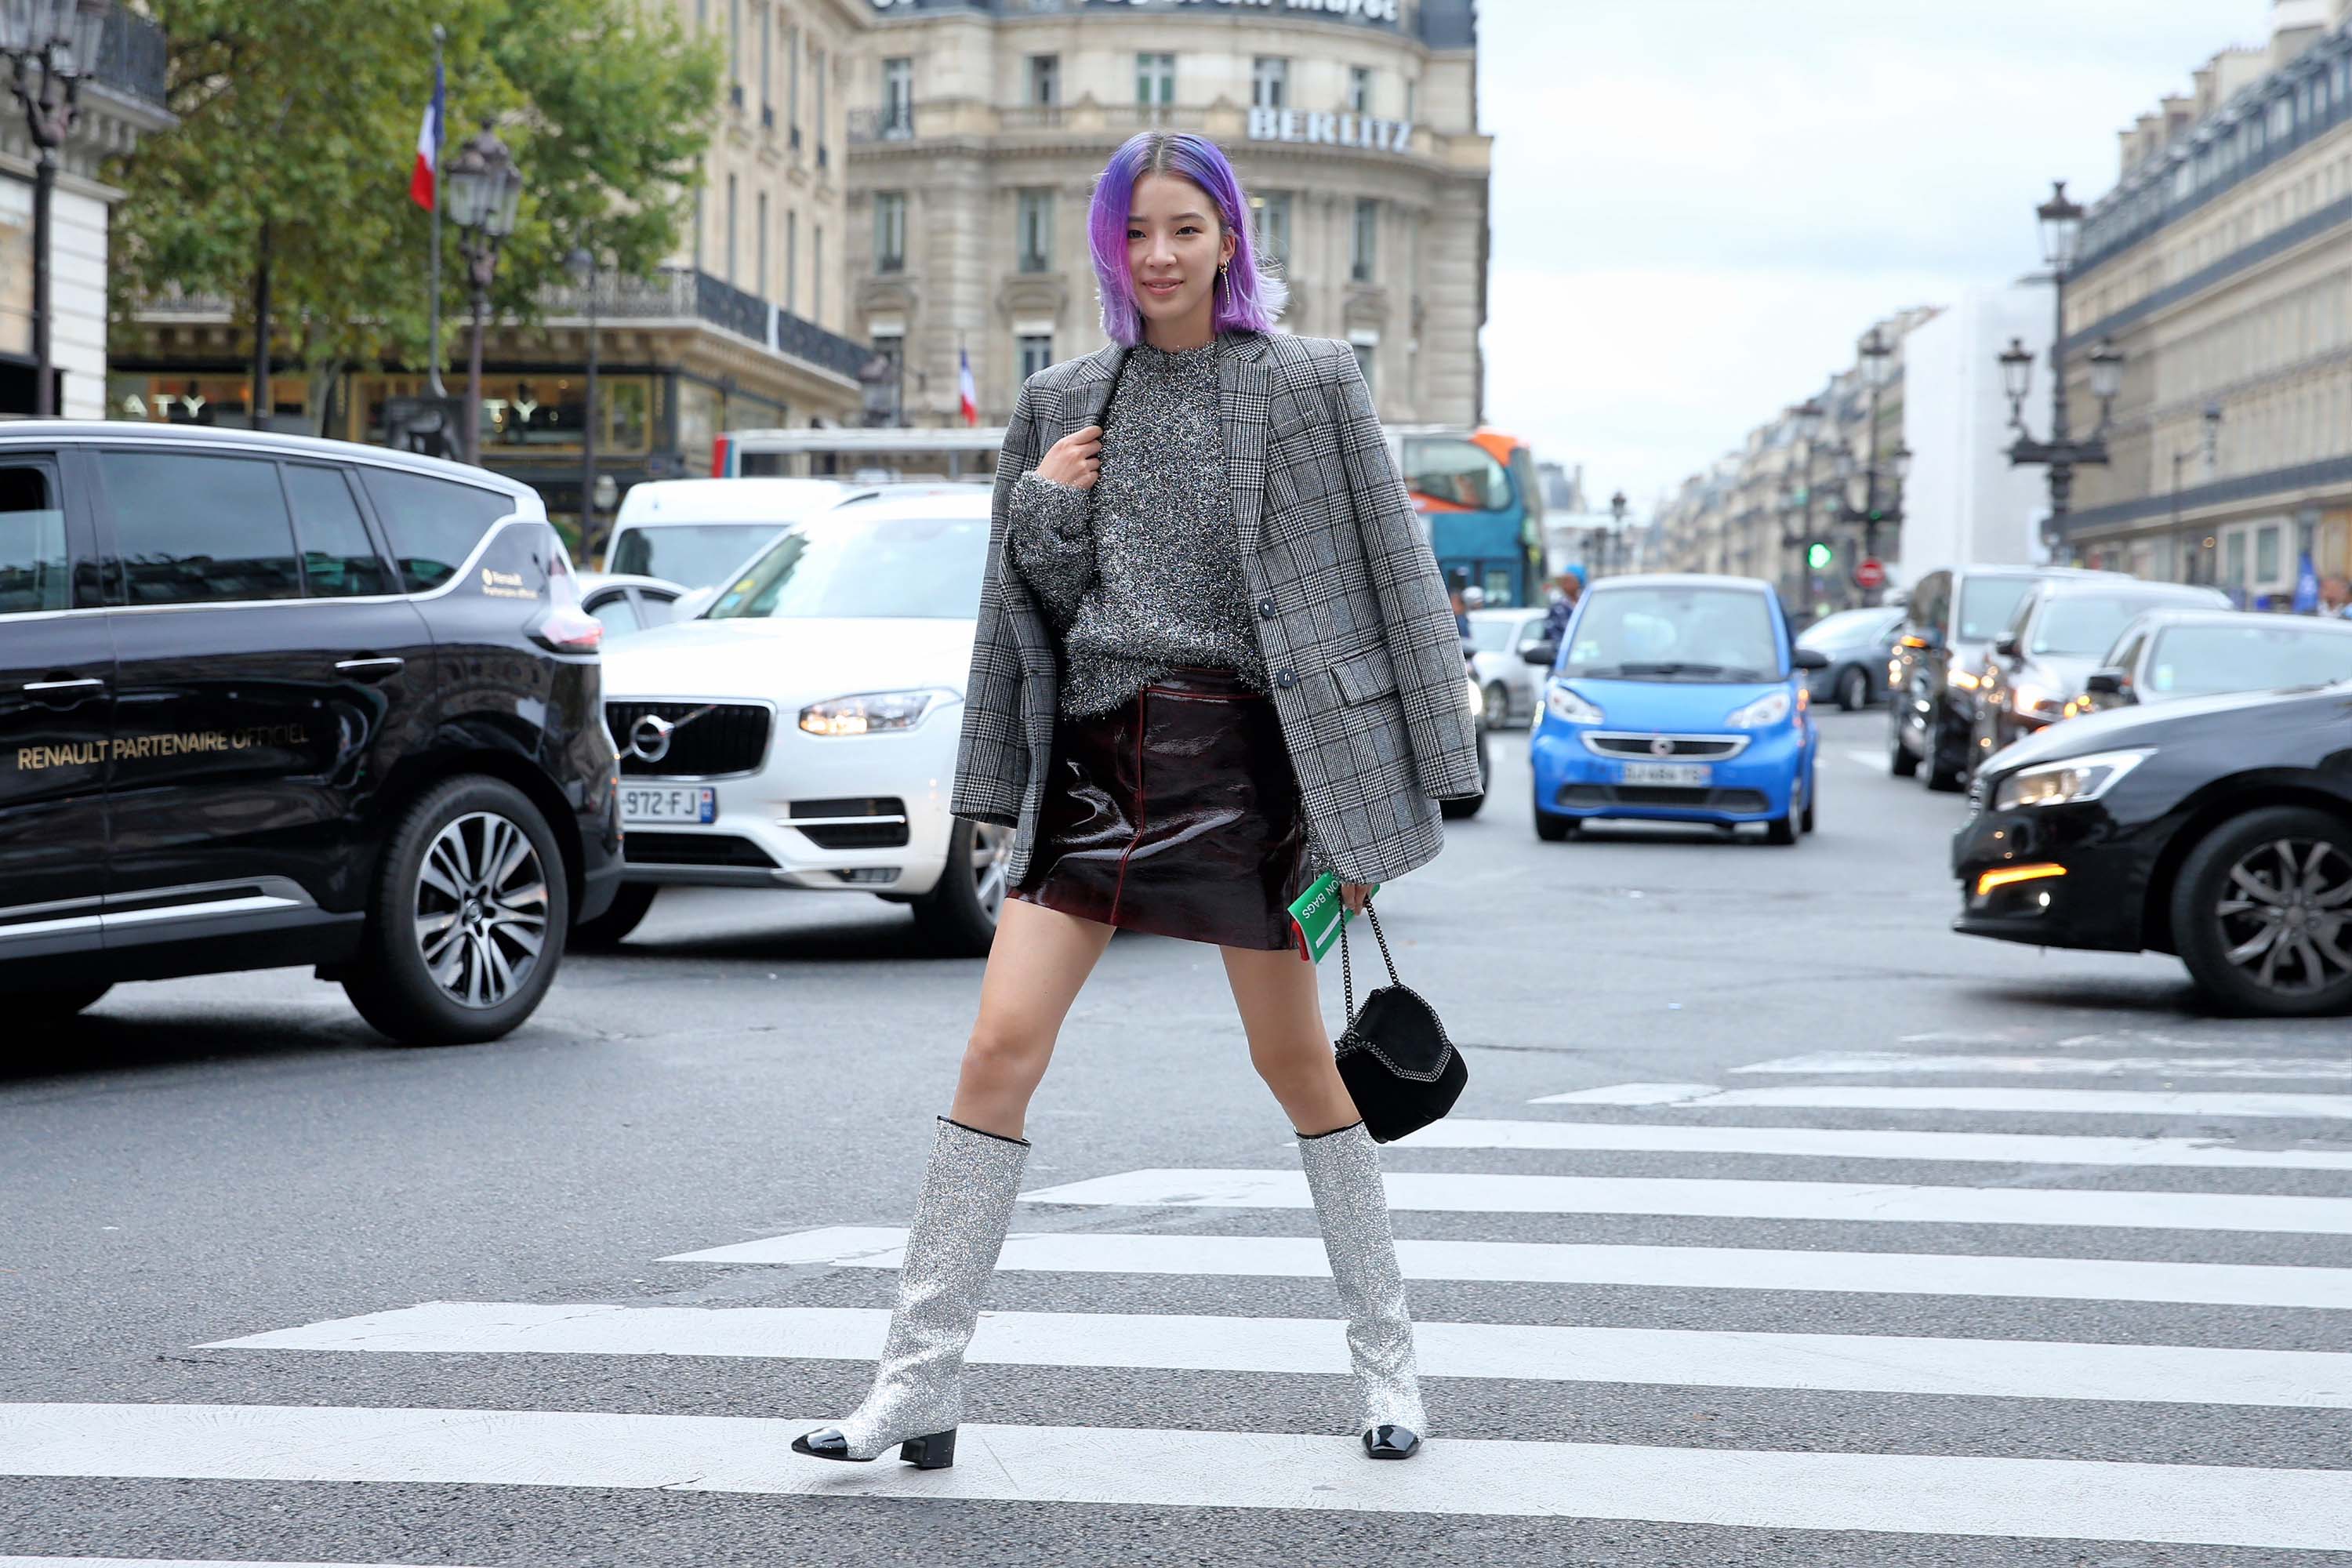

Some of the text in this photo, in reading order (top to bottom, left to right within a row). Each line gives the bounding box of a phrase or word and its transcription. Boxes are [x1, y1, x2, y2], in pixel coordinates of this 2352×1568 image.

[1247, 106, 1413, 154] BERLITZ
[18, 739, 109, 771] RENAULT
[112, 731, 228, 760] PARTENAIRE
[1301, 892, 1327, 920] BAGS
